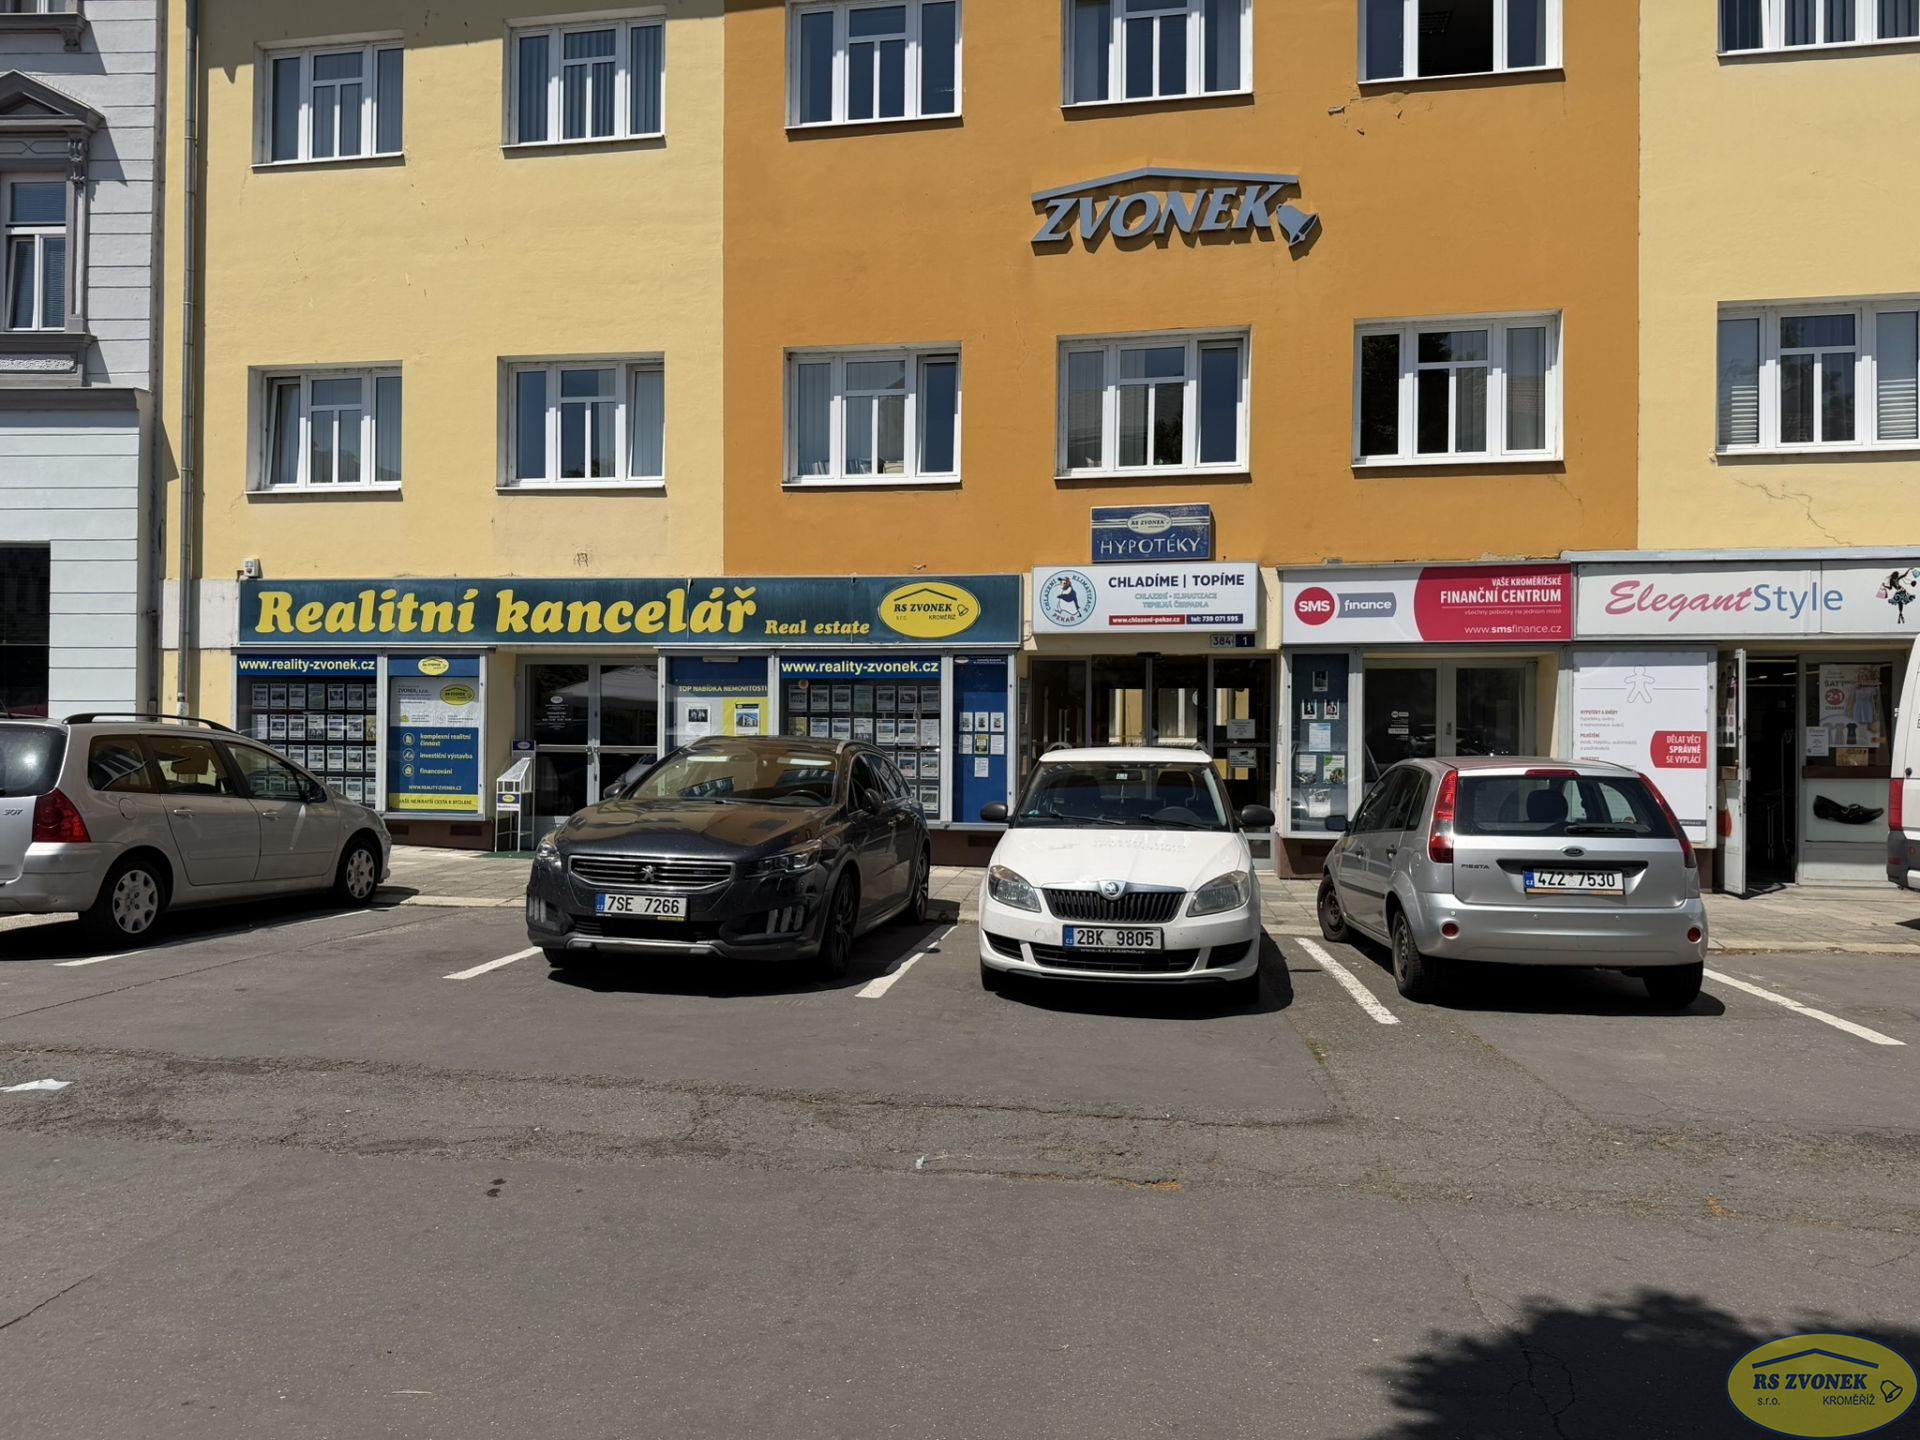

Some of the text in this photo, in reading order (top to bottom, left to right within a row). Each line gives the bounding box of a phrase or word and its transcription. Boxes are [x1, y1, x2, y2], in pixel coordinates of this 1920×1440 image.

[1031, 183, 1285, 242] ZVONEK
[1100, 533, 1201, 555] HYPOTÉKY
[1108, 572, 1245, 588] CHLADÍME TOPÍME
[1491, 575, 1562, 587] VAŠE KROMĚŘÍŽSKÉ
[1440, 587, 1562, 604] FINANČNÍ CENTRUM
[1604, 579, 1844, 623] ElegantStyle
[254, 585, 758, 634] Realitní kancelář
[893, 603, 953, 613] RS ZVONEK
[1298, 599, 1392, 612] SMS finance
[764, 618, 870, 635] Real estate
[1202, 615, 1214, 623] 739
[1215, 615, 1226, 623] 071
[1226, 615, 1239, 623] 595
[1464, 624, 1562, 634] www.smsfinance.cz
[1213, 636, 1232, 646] 384
[239, 658, 375, 673] www.reality-zvonek.cz
[781, 659, 939, 677] www.reality-zvonek.cz
[1666, 733, 1701, 743] DĚLAT VĚCI
[447, 752, 473, 760] výstavba
[1668, 744, 1701, 754] SPRÁVNĚ
[1666, 754, 1701, 764] SE VYPLÁCÍ
[420, 767, 453, 775] financování
[1537, 871, 1567, 887] 4Z2
[1577, 872, 1616, 888] 7530
[606, 895, 634, 912] 7SE
[644, 897, 680, 914] 7266
[1077, 928, 1104, 945] 2BK
[1116, 930, 1154, 946] 9805
